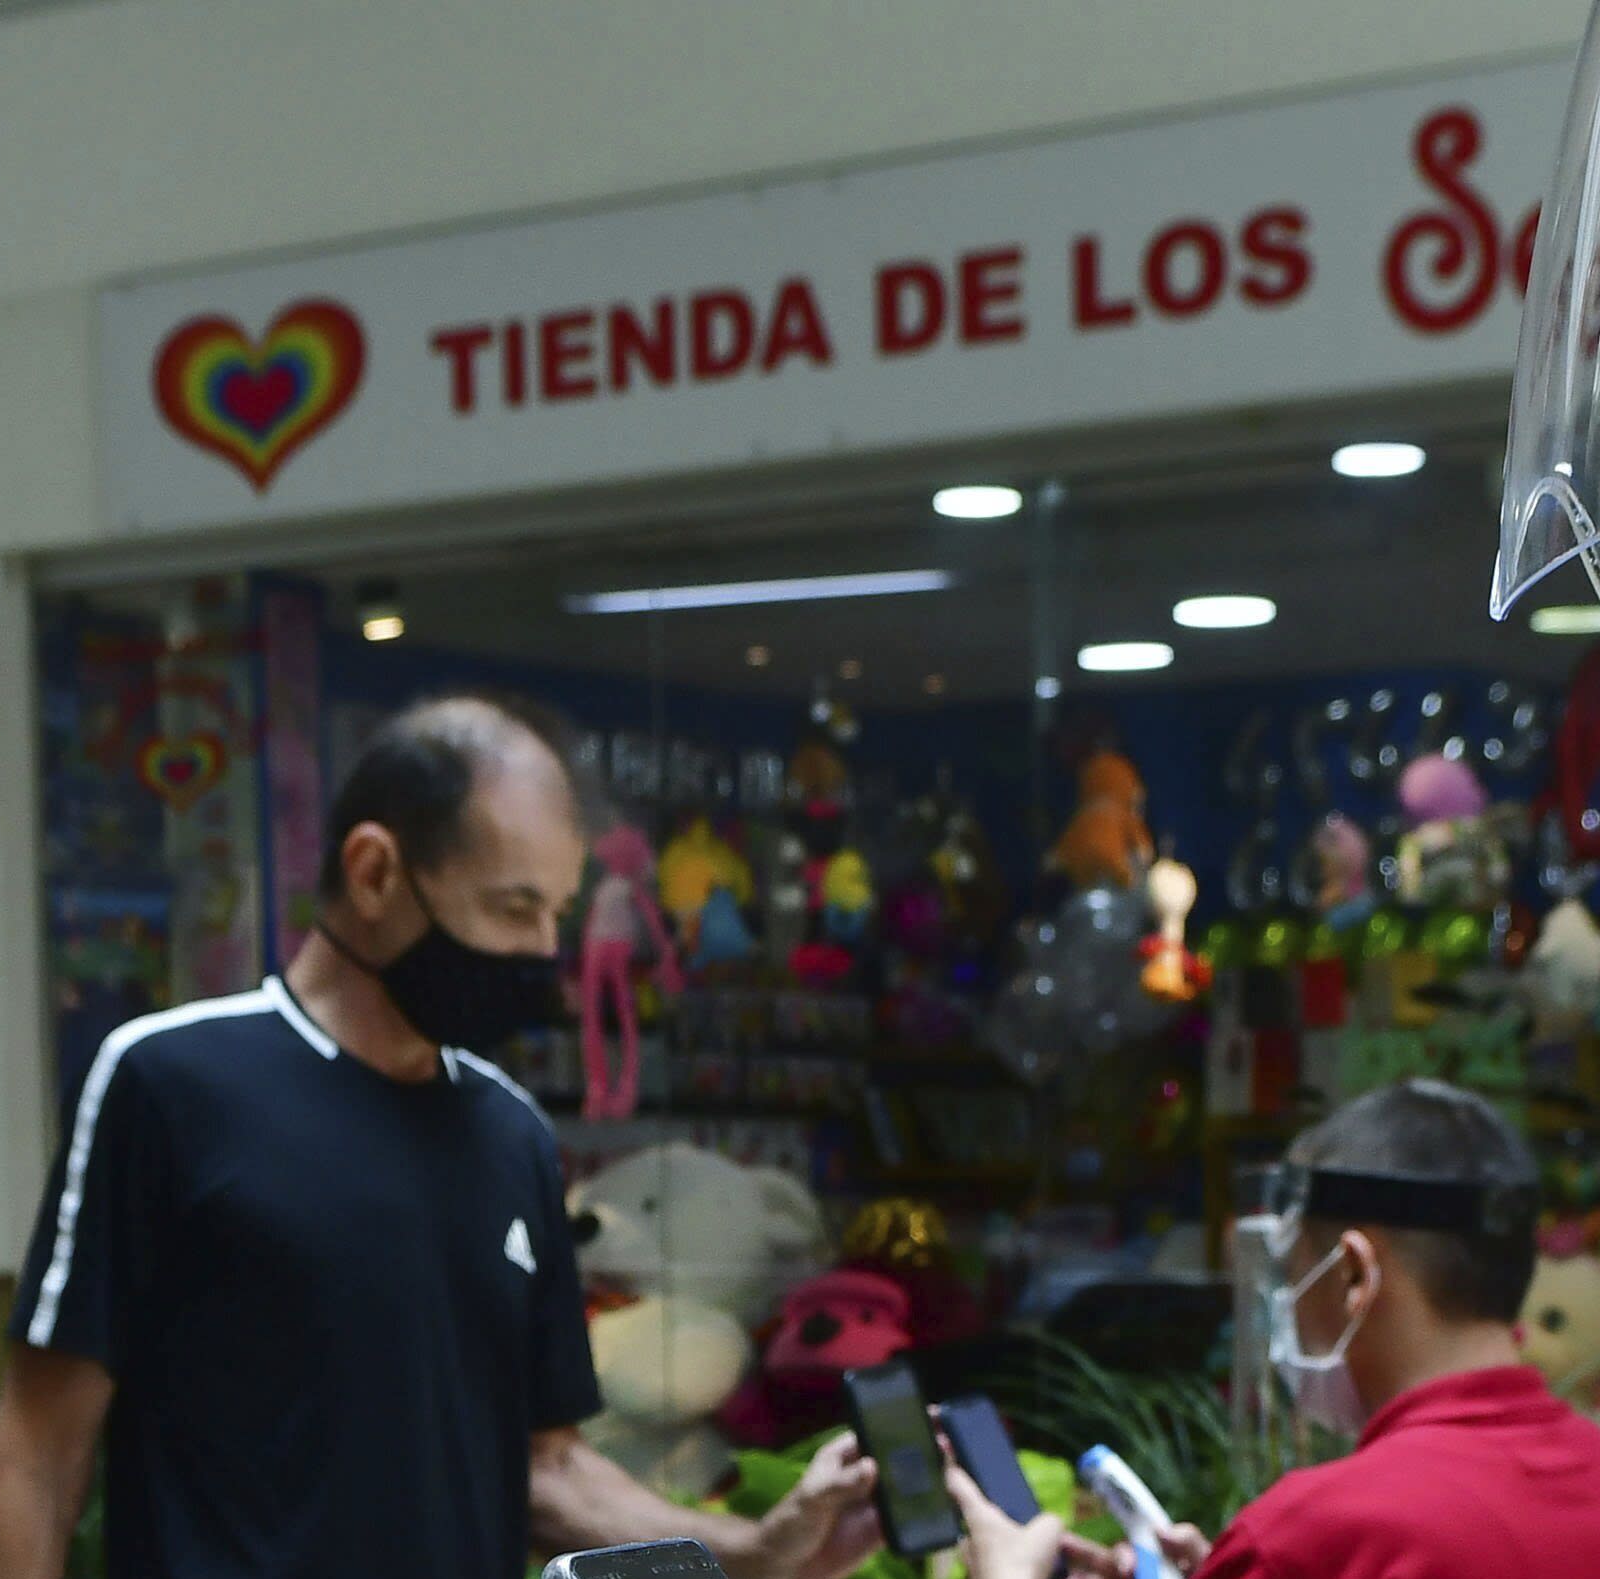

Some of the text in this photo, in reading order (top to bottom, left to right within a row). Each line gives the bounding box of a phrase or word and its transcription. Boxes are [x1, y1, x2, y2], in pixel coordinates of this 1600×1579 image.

[430, 281, 832, 413] TIENDA
[876, 246, 1023, 355] DE
[1072, 207, 1312, 329] LOS
